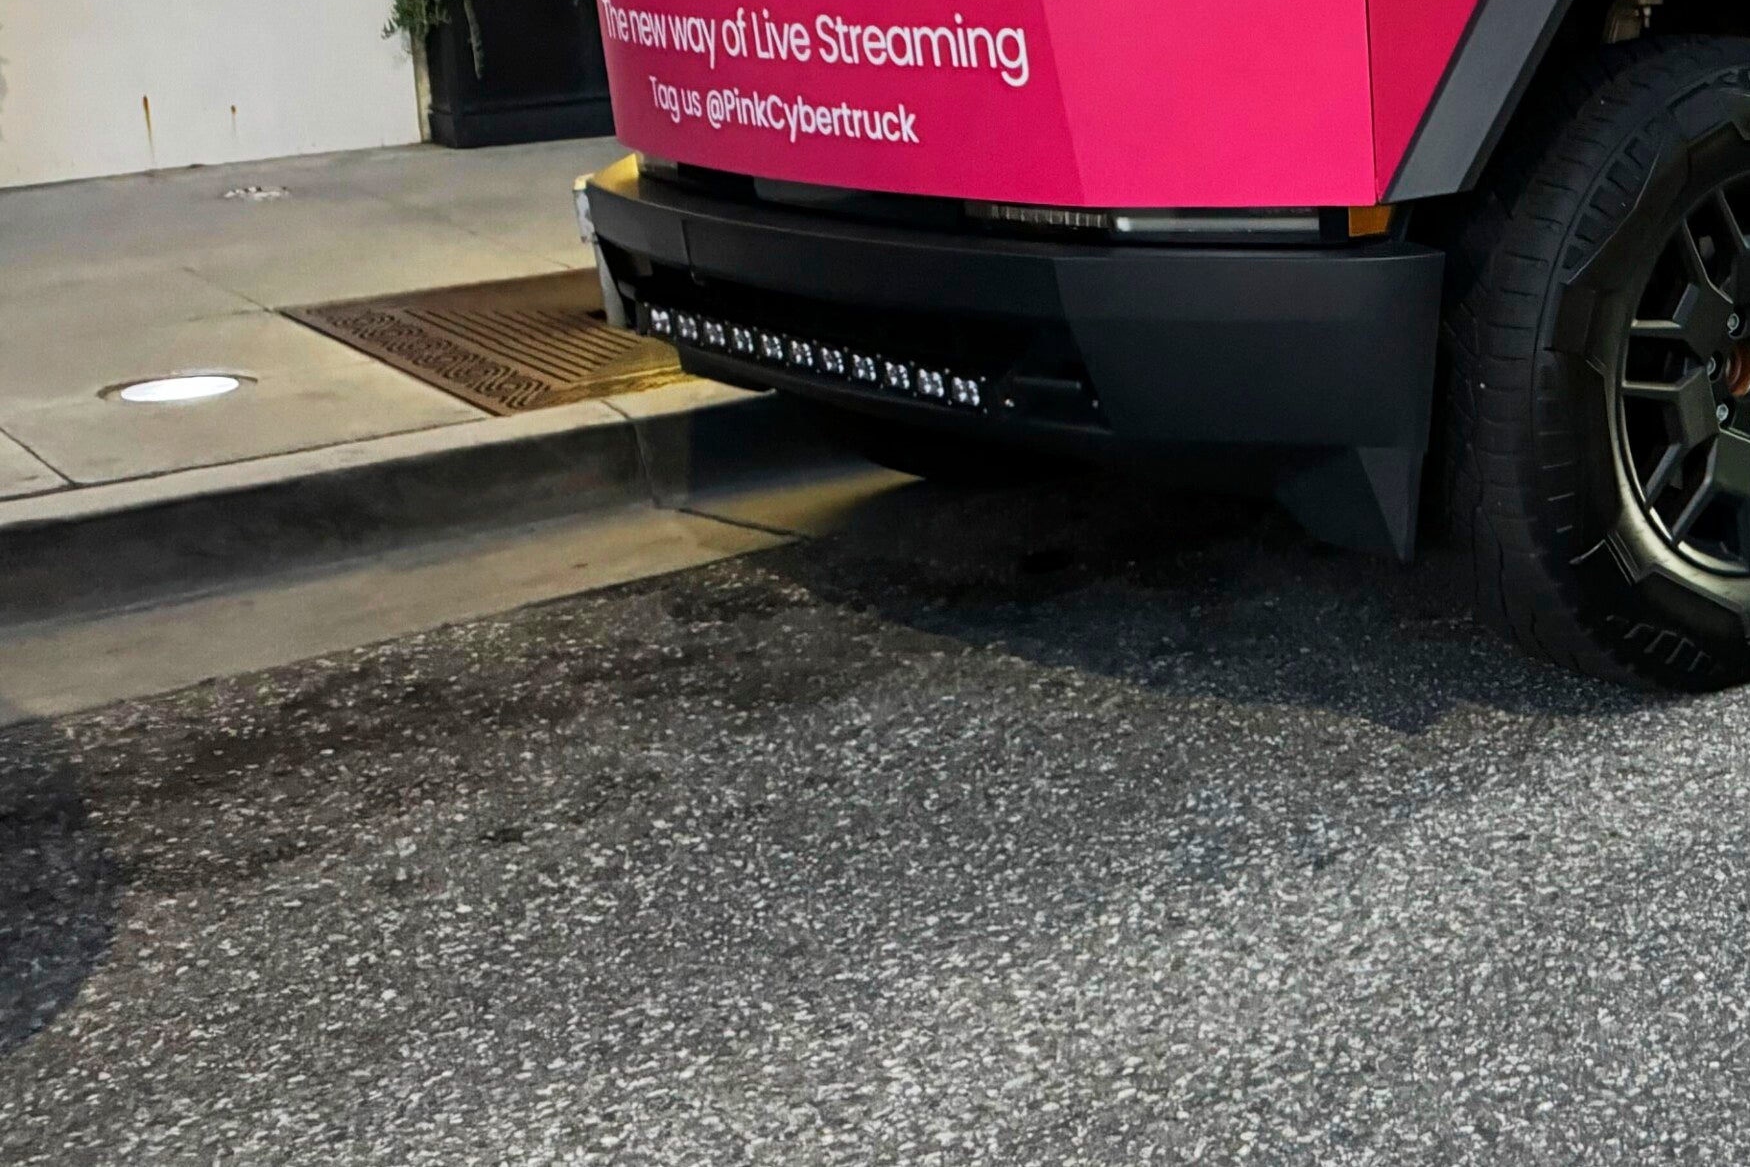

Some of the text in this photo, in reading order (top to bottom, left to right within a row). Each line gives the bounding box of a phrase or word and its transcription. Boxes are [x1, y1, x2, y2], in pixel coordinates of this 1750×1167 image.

[629, 9, 667, 50] new
[668, 14, 715, 70] way
[721, 6, 748, 58] of
[751, 7, 812, 63] Live
[818, 13, 1030, 88] Streaming
[649, 75, 921, 144] Tag us @PinkCybertruck
